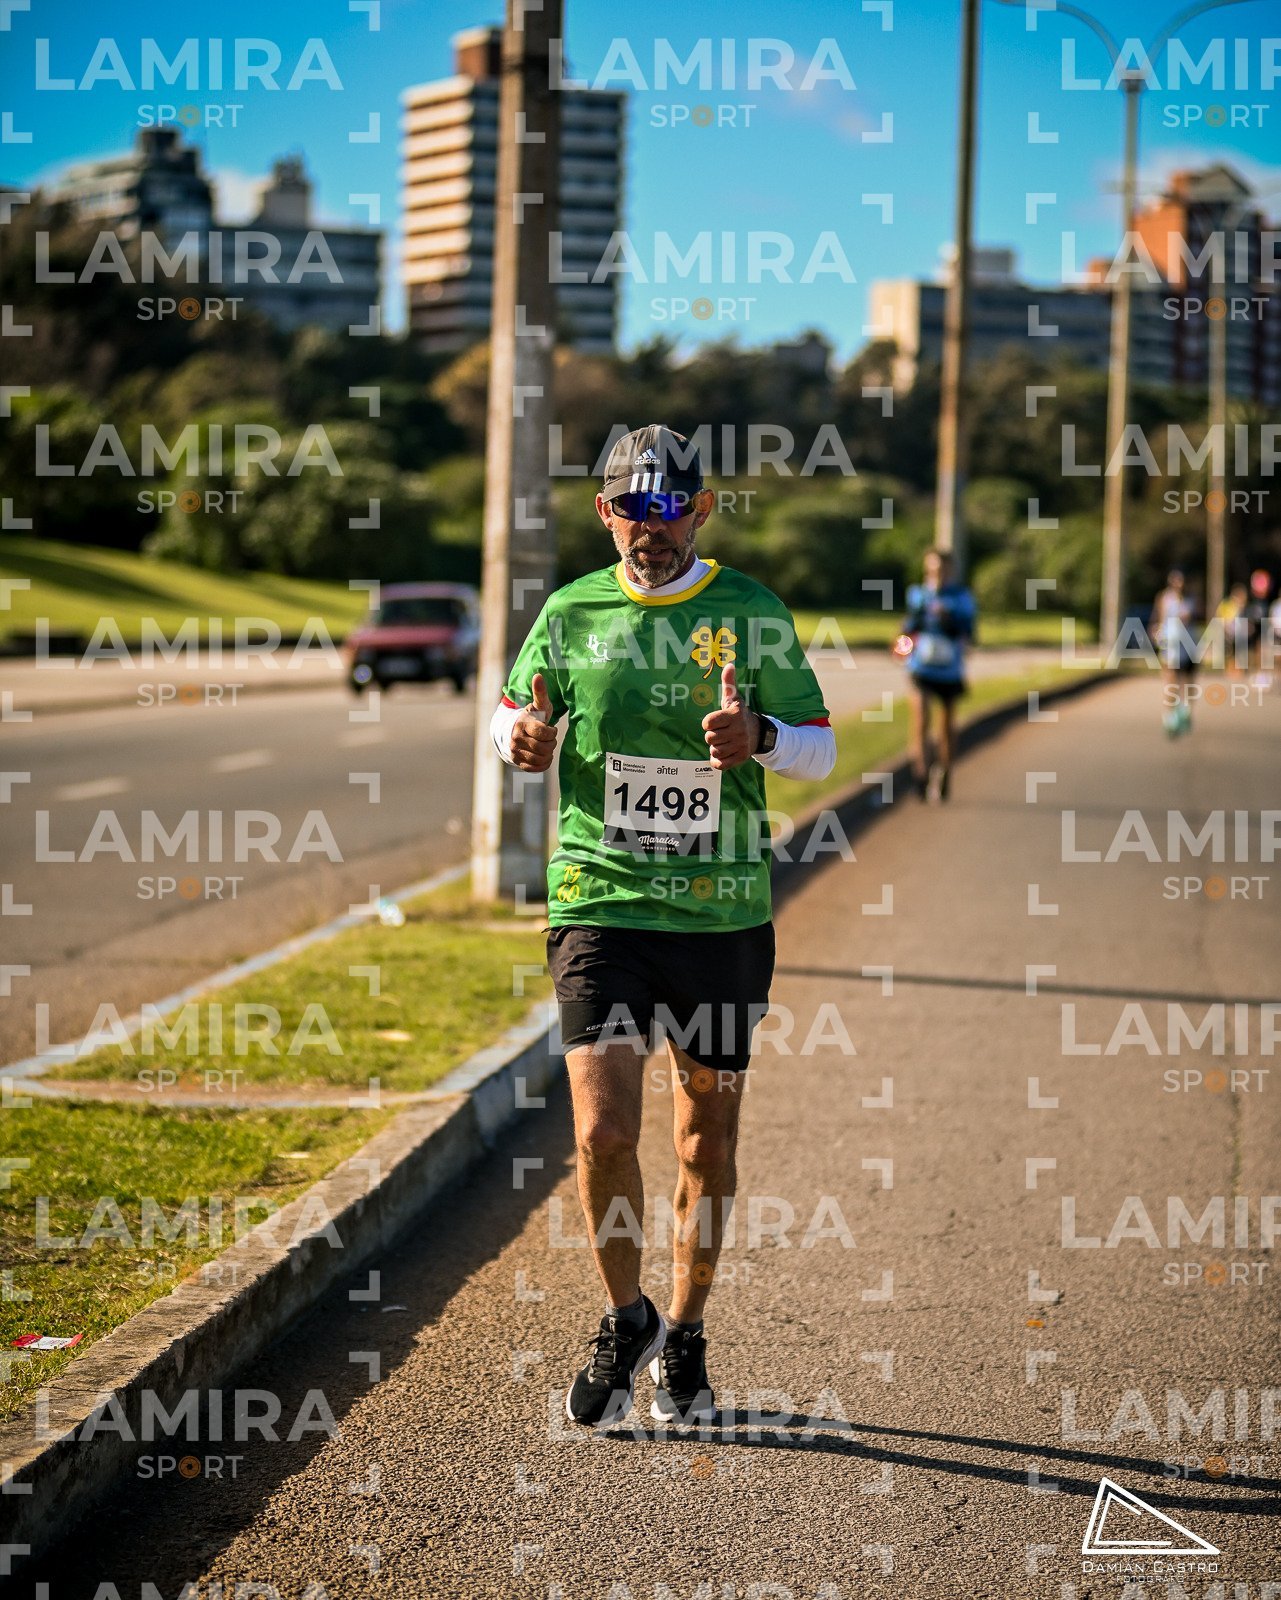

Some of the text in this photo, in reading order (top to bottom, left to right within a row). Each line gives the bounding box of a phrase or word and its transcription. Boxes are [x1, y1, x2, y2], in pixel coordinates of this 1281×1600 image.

[656, 765, 678, 775] antel
[614, 782, 710, 821] 1498
[638, 835, 680, 847] Maratón
[563, 865, 581, 883] 19
[557, 884, 580, 903] 60
